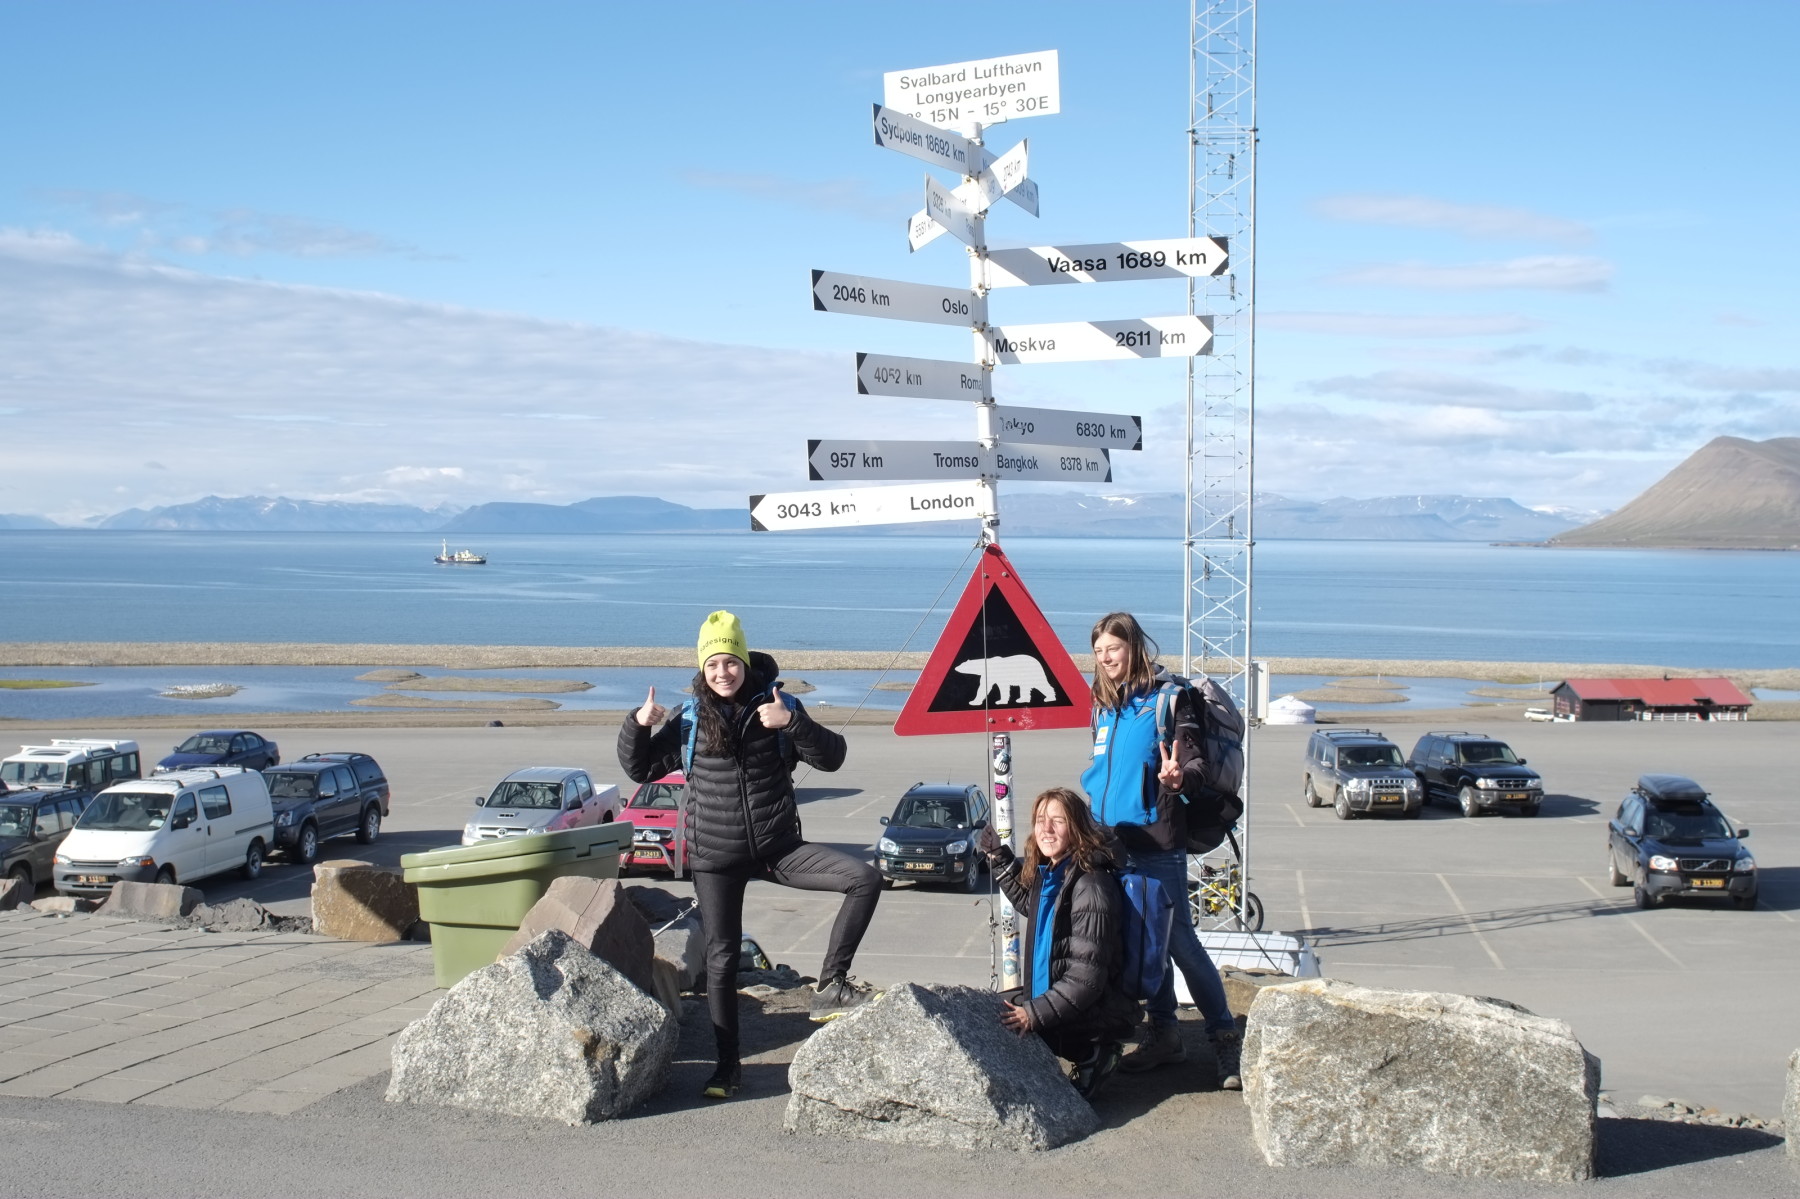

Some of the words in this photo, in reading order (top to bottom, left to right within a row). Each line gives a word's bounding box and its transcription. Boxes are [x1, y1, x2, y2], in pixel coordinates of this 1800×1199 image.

[899, 69, 967, 90] Svalbard
[974, 61, 1043, 80] Lufthavn
[916, 80, 1027, 106] Longyearbyen
[881, 116, 923, 148] Sydpolen
[925, 133, 951, 158] 18692
[952, 143, 966, 164] km
[1047, 257, 1107, 274] Vaasa
[1116, 250, 1167, 270] 1689
[1176, 249, 1208, 266] km
[832, 284, 866, 304] 2046
[871, 289, 890, 307] km
[942, 298, 969, 316] Oslo
[995, 337, 1056, 353] Moskva
[1115, 330, 1151, 347] 2611
[1159, 330, 1186, 345] km
[874, 366, 901, 385] 4052
[906, 369, 922, 386] km
[960, 374, 983, 391] Roma
[1076, 422, 1106, 438] 6830
[1110, 424, 1126, 439] km
[830, 452, 856, 468] 957
[862, 452, 883, 468] km
[933, 452, 979, 469] Tromsø
[997, 454, 1039, 473] Bangkok
[1060, 456, 1083, 472] 8378
[1085, 458, 1099, 472] km
[777, 502, 822, 519] 3043
[830, 502, 857, 516] km
[910, 494, 975, 511] London
